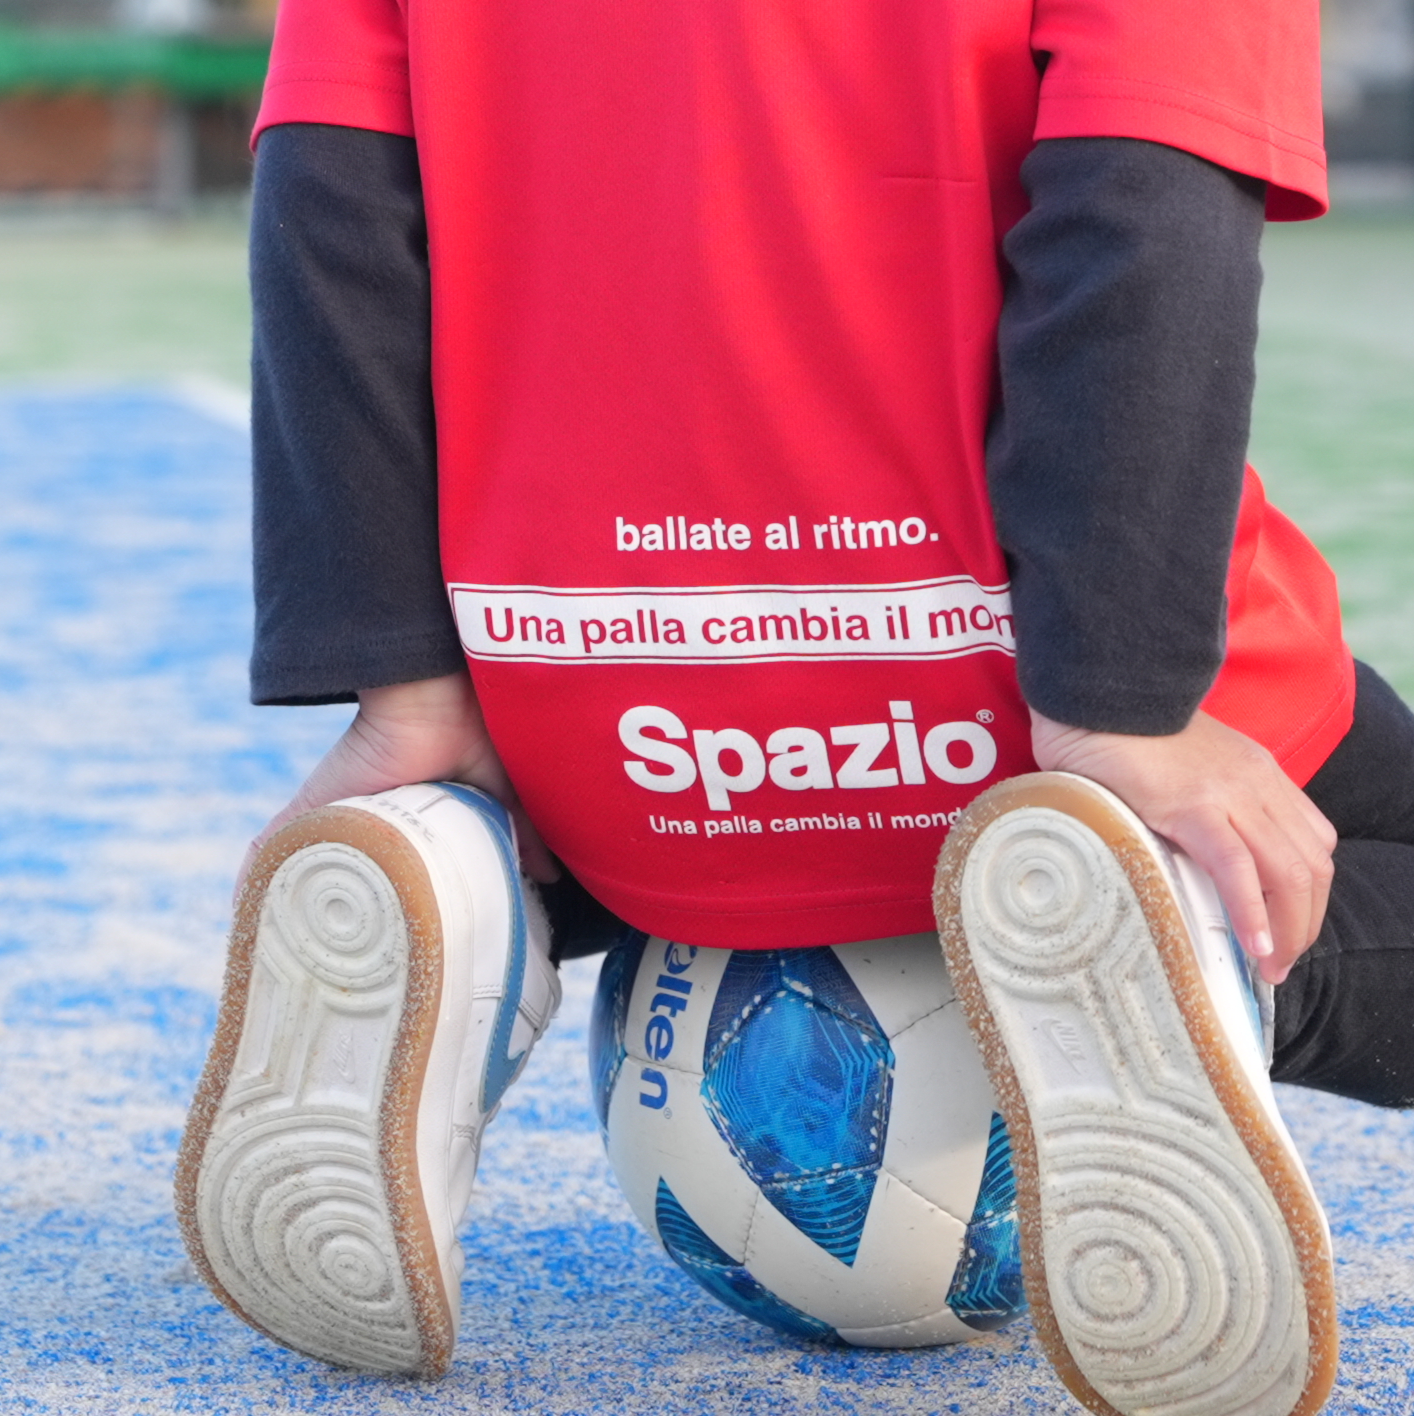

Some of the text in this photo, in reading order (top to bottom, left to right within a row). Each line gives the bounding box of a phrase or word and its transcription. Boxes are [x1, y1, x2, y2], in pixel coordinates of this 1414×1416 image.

[616, 516, 939, 551] ballate al ritmo.
[485, 604, 1016, 653] Una palla cambia il mon
[649, 815, 697, 835] Una
[704, 815, 763, 838] palla
[769, 813, 862, 833] cambia
[867, 812, 883, 829] il
